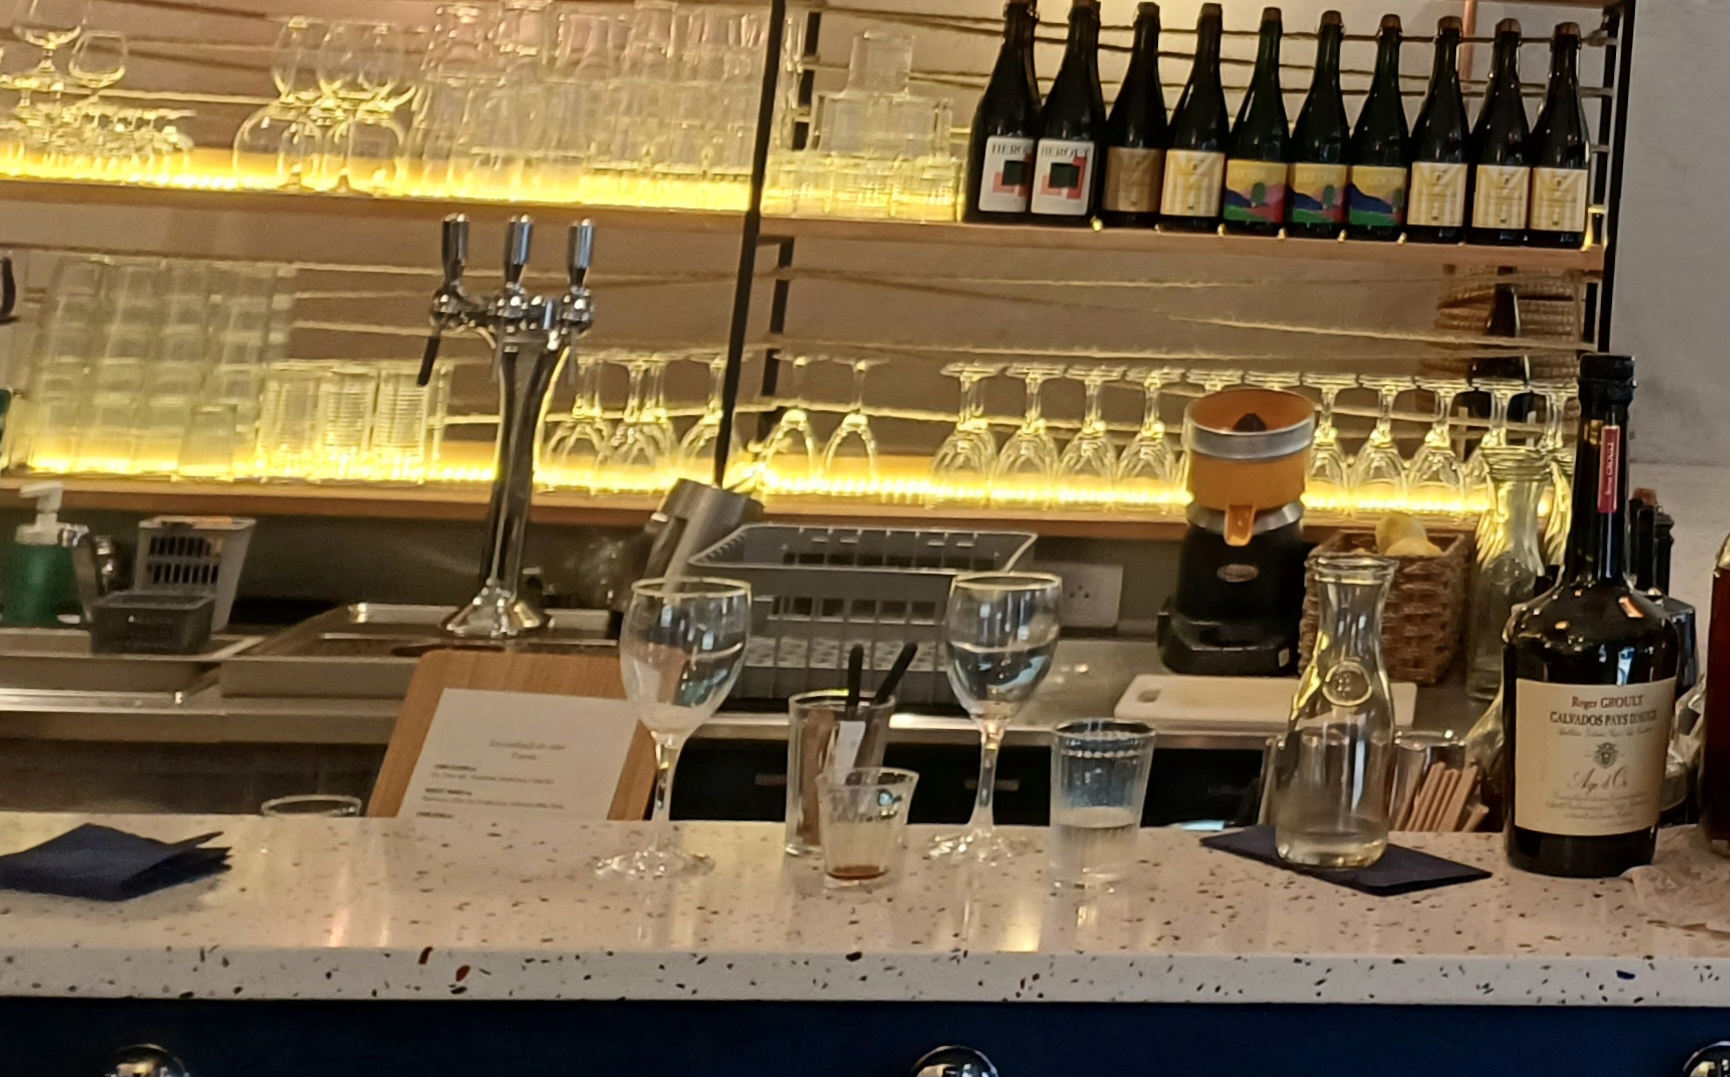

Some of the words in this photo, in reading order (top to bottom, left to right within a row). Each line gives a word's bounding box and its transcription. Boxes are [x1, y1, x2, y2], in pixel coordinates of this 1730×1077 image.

[1571, 696, 1598, 711] Roger
[1600, 693, 1645, 709] GROULT
[1549, 710, 1603, 727] CALVADOS
[1604, 713, 1629, 727] PAYS
